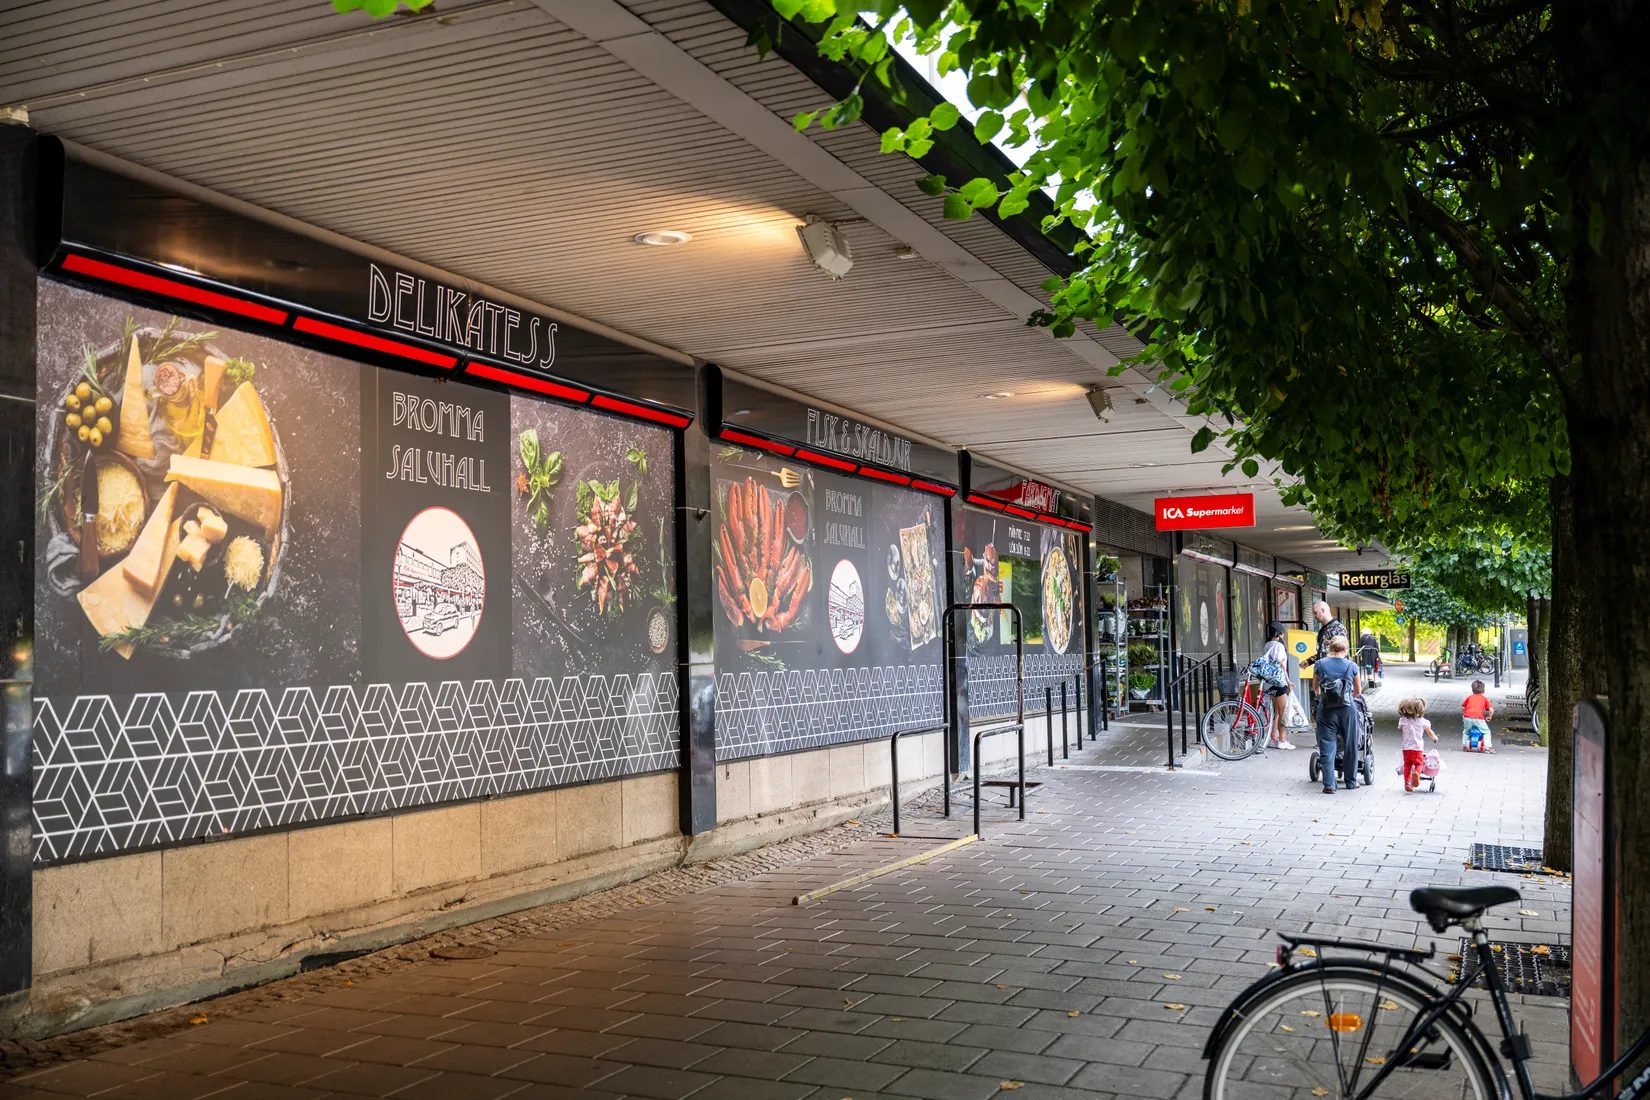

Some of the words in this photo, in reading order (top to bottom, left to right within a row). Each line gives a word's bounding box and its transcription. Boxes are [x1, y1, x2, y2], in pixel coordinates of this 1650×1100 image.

[368, 263, 558, 369] DELIKATESS
[393, 391, 484, 442] BROMMA
[806, 408, 839, 451] FISK
[841, 420, 851, 454] &
[853, 424, 912, 472] SKALDJUR
[386, 444, 491, 492] SALUHALL
[825, 488, 863, 517] BROMMA
[1163, 507, 1185, 520] ICA
[1186, 505, 1244, 519] Supermarket
[823, 522, 866, 549] SALUHALL
[1341, 571, 1408, 589] Returglas
